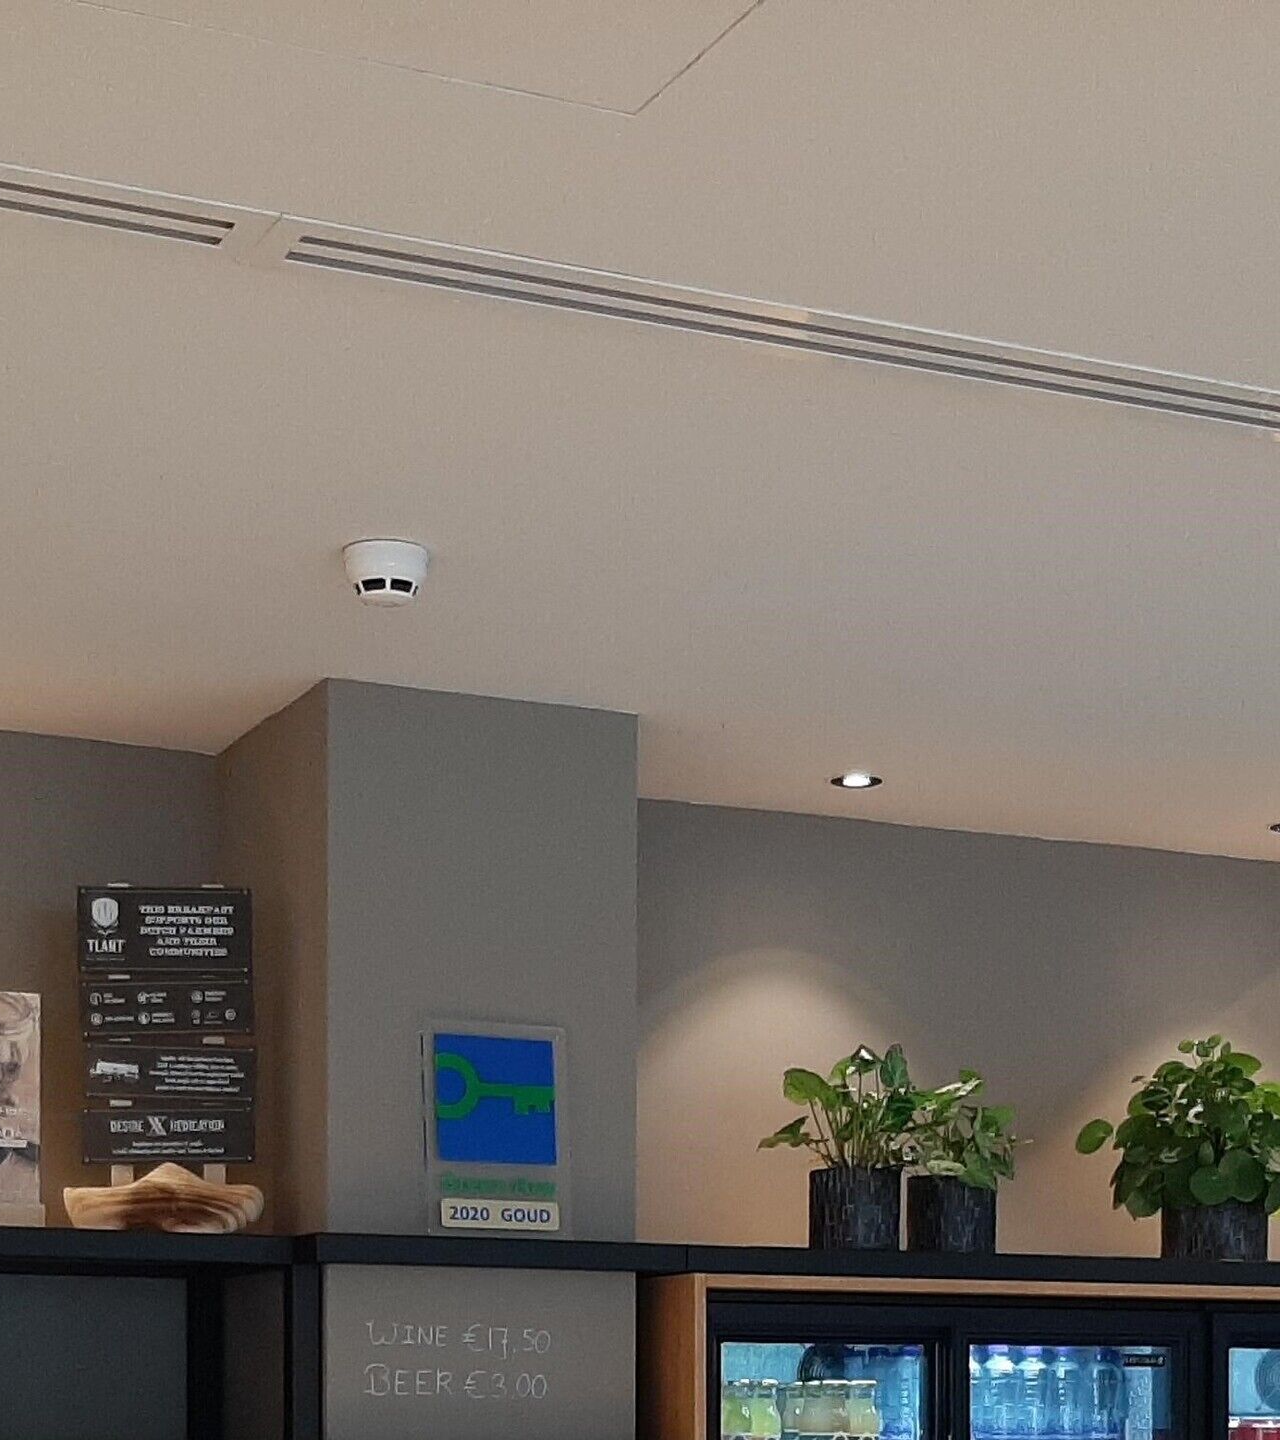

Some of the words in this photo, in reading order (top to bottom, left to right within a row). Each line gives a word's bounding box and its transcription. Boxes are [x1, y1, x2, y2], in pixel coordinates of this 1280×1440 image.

[449, 1206, 490, 1221] 2020
[501, 1208, 551, 1223] GOUD
[365, 1321, 449, 1347] WINE
[364, 1363, 452, 1396] BEER
